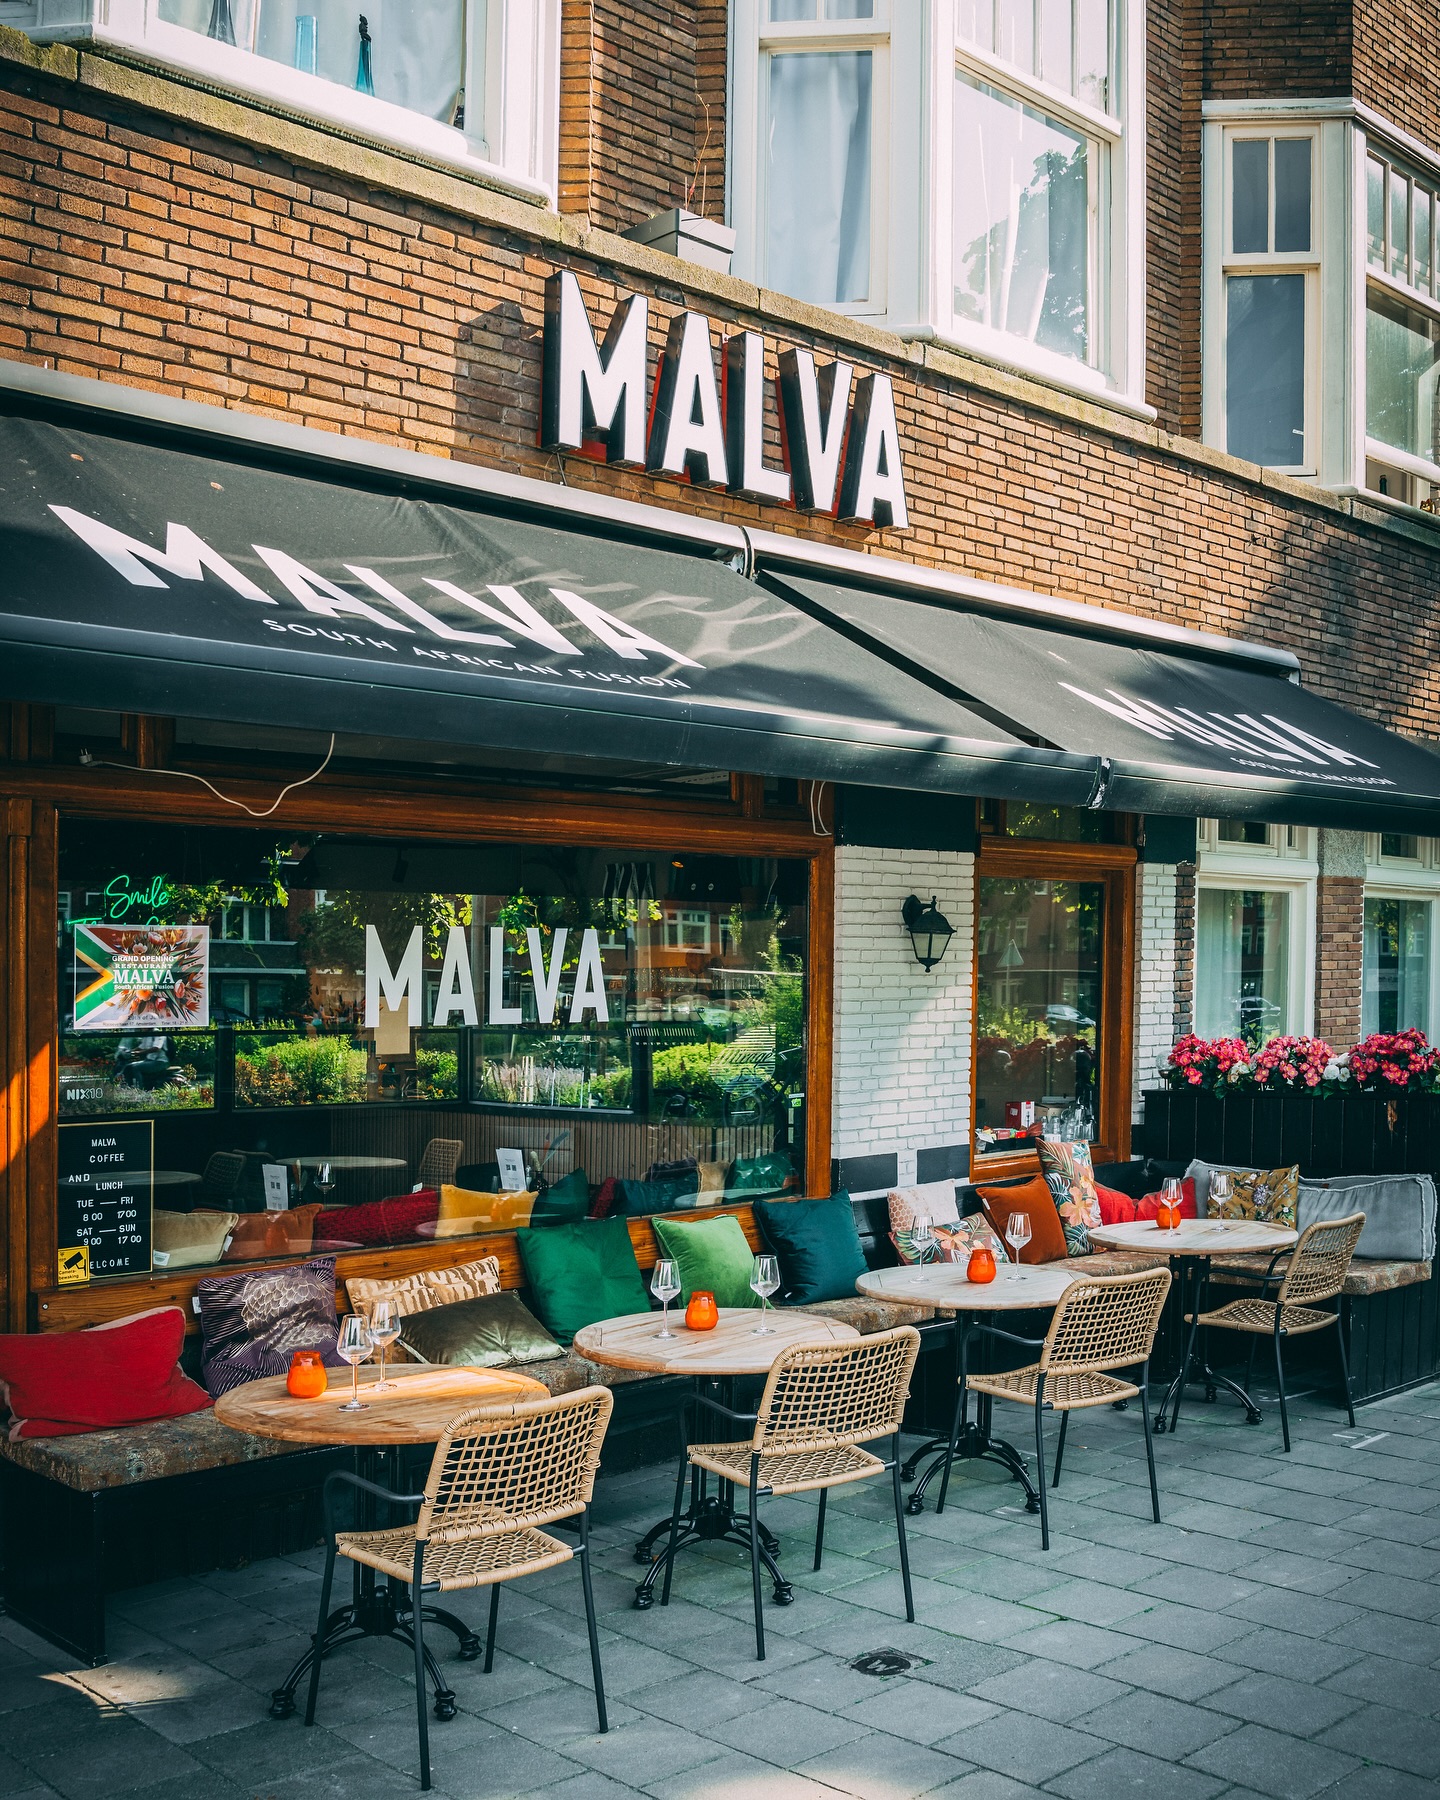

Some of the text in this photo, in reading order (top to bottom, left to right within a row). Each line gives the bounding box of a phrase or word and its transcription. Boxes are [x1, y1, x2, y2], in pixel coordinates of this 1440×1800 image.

[543, 270, 910, 530] MALVA
[48, 504, 706, 669] MALVA
[262, 619, 691, 690] SOUTH AFRICAN FUSION
[1057, 682, 1381, 769] MALVA
[106, 875, 168, 919] Smile
[113, 969, 175, 984] MALVA
[364, 924, 609, 1028] MALVA
[66, 1088, 104, 1101] NIX18
[91, 1138, 117, 1147] MALVA
[89, 1153, 125, 1163] COFFEE
[68, 1173, 90, 1183] AND
[95, 1181, 123, 1191] LUNCH
[77, 1196, 134, 1209] TUE FRI
[76, 1223, 136, 1237] SAT SUN
[89, 1257, 130, 1270] ELCOME
